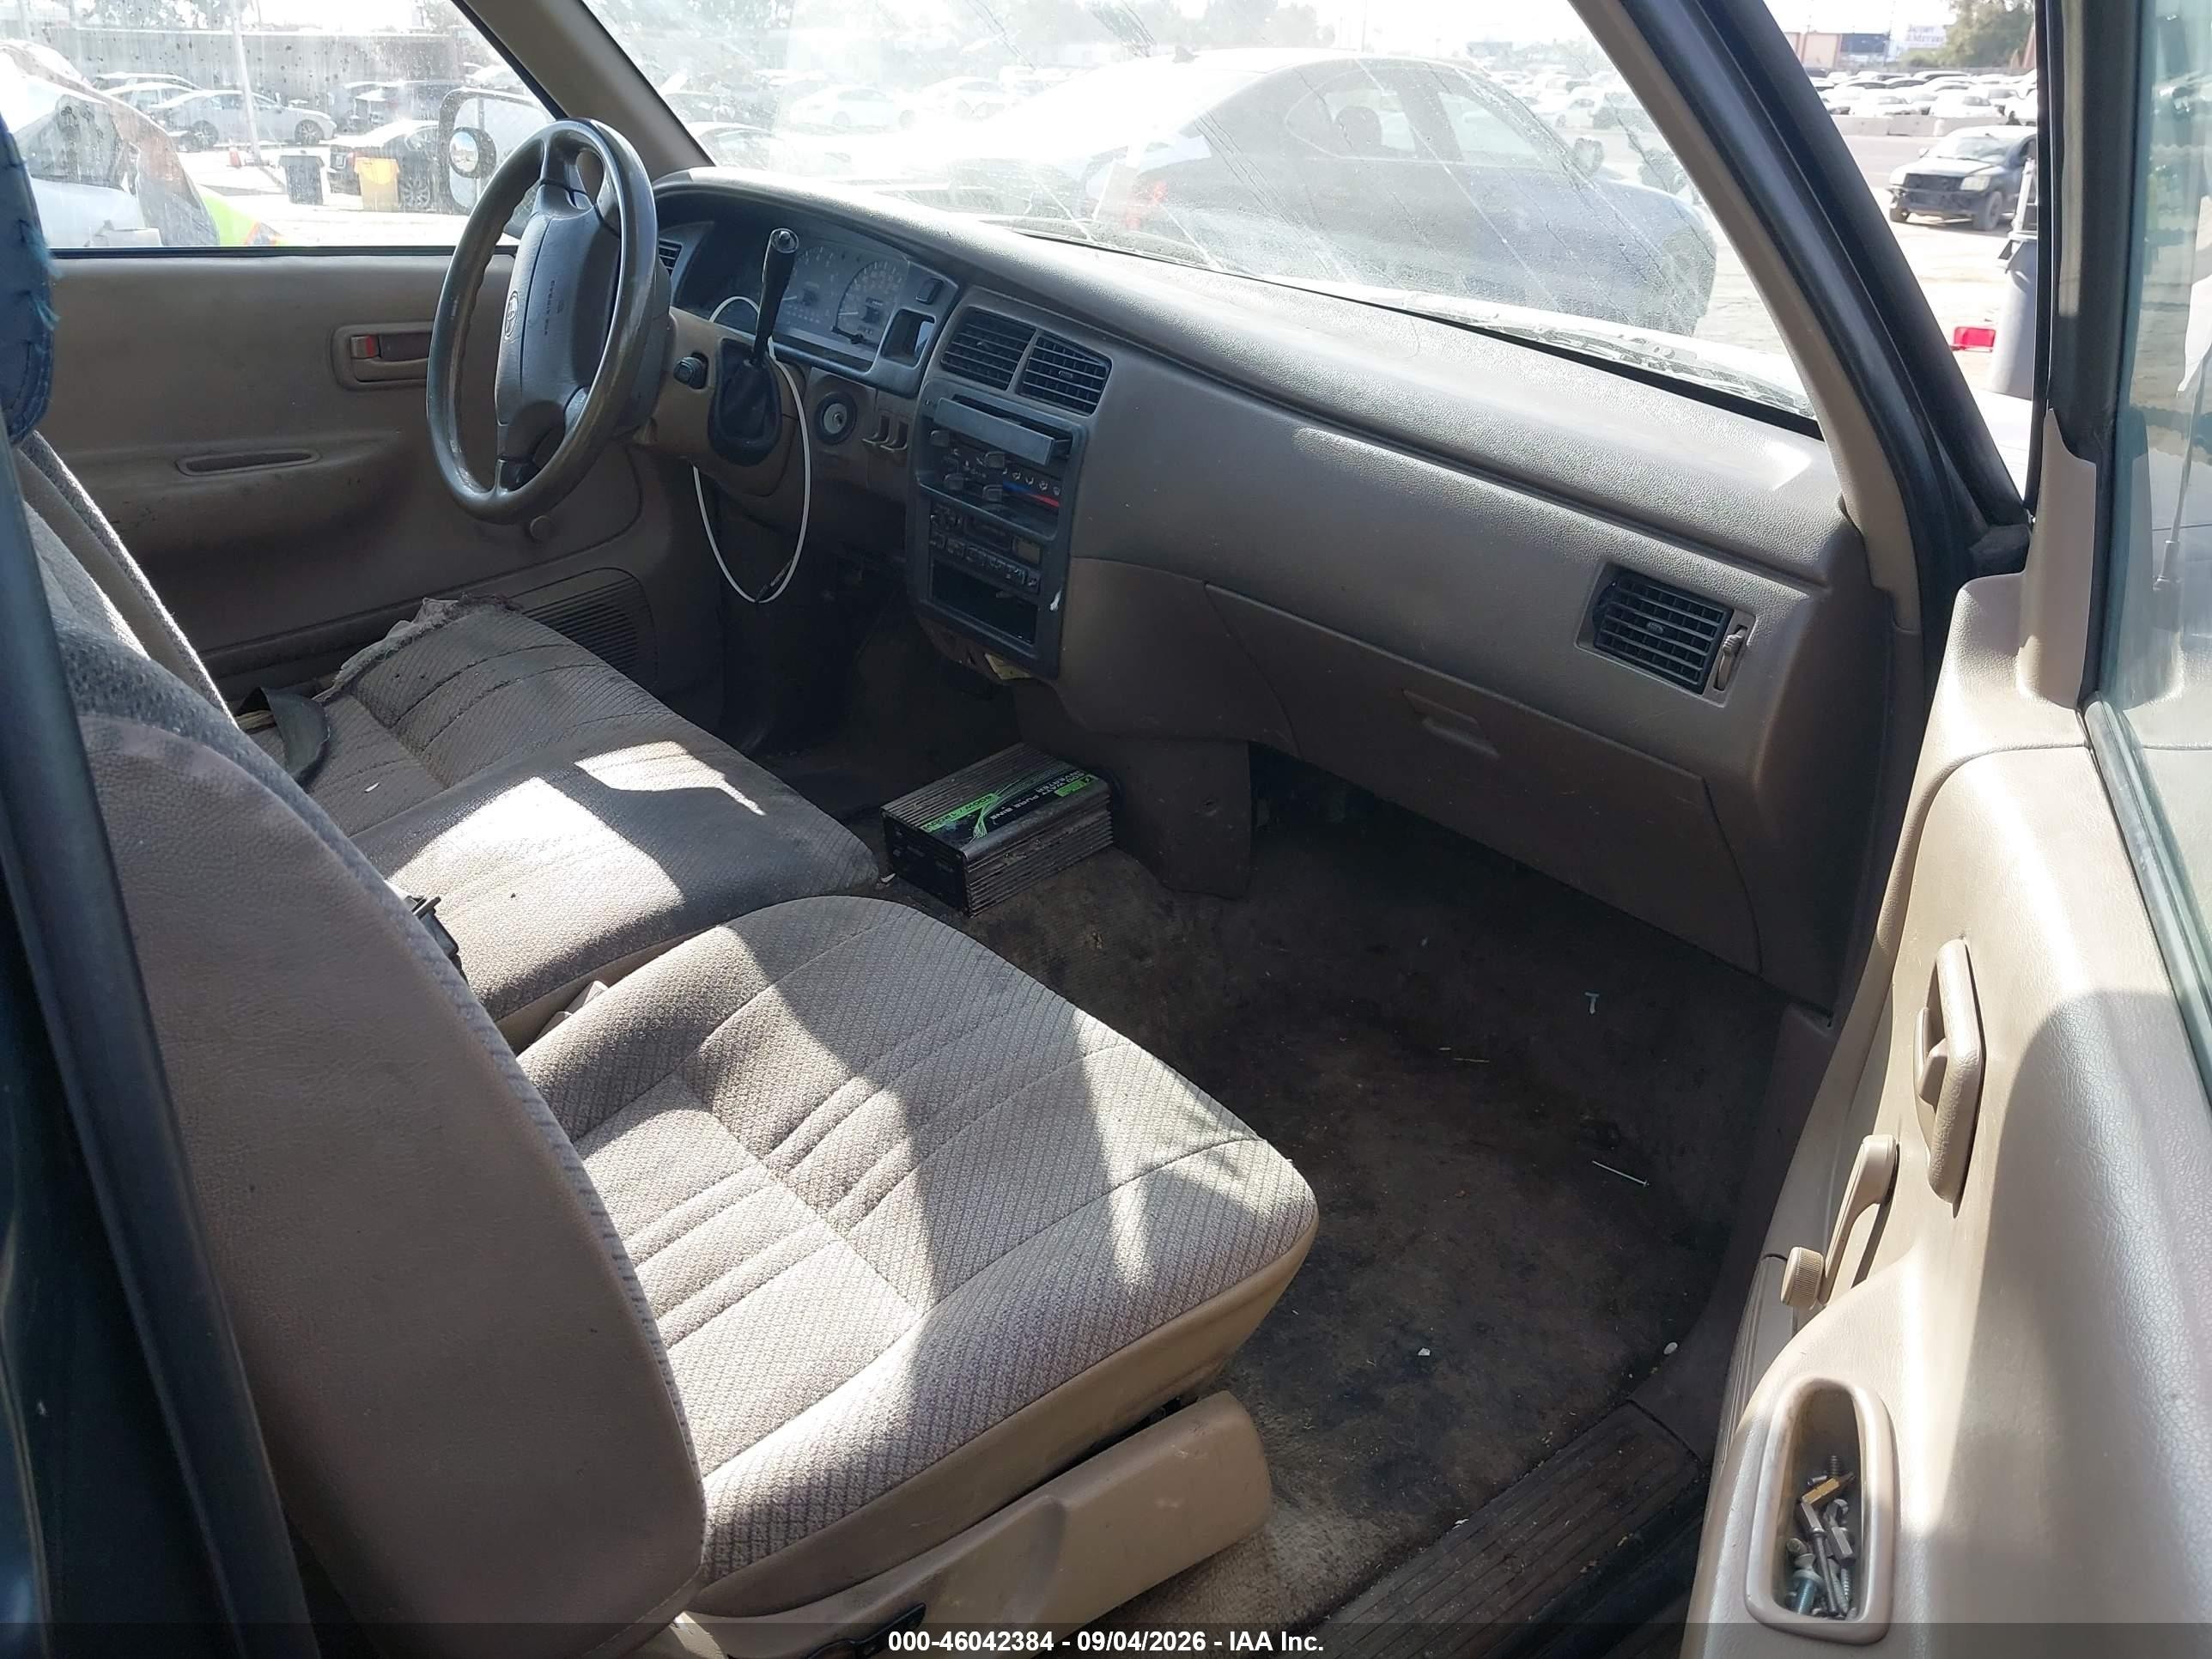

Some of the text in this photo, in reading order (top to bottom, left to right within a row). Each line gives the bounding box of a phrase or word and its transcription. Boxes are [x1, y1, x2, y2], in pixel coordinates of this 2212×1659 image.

[1041, 781, 1066, 796] WATT
[1013, 794, 1040, 809] PURE
[989, 806, 1013, 821] SINE
